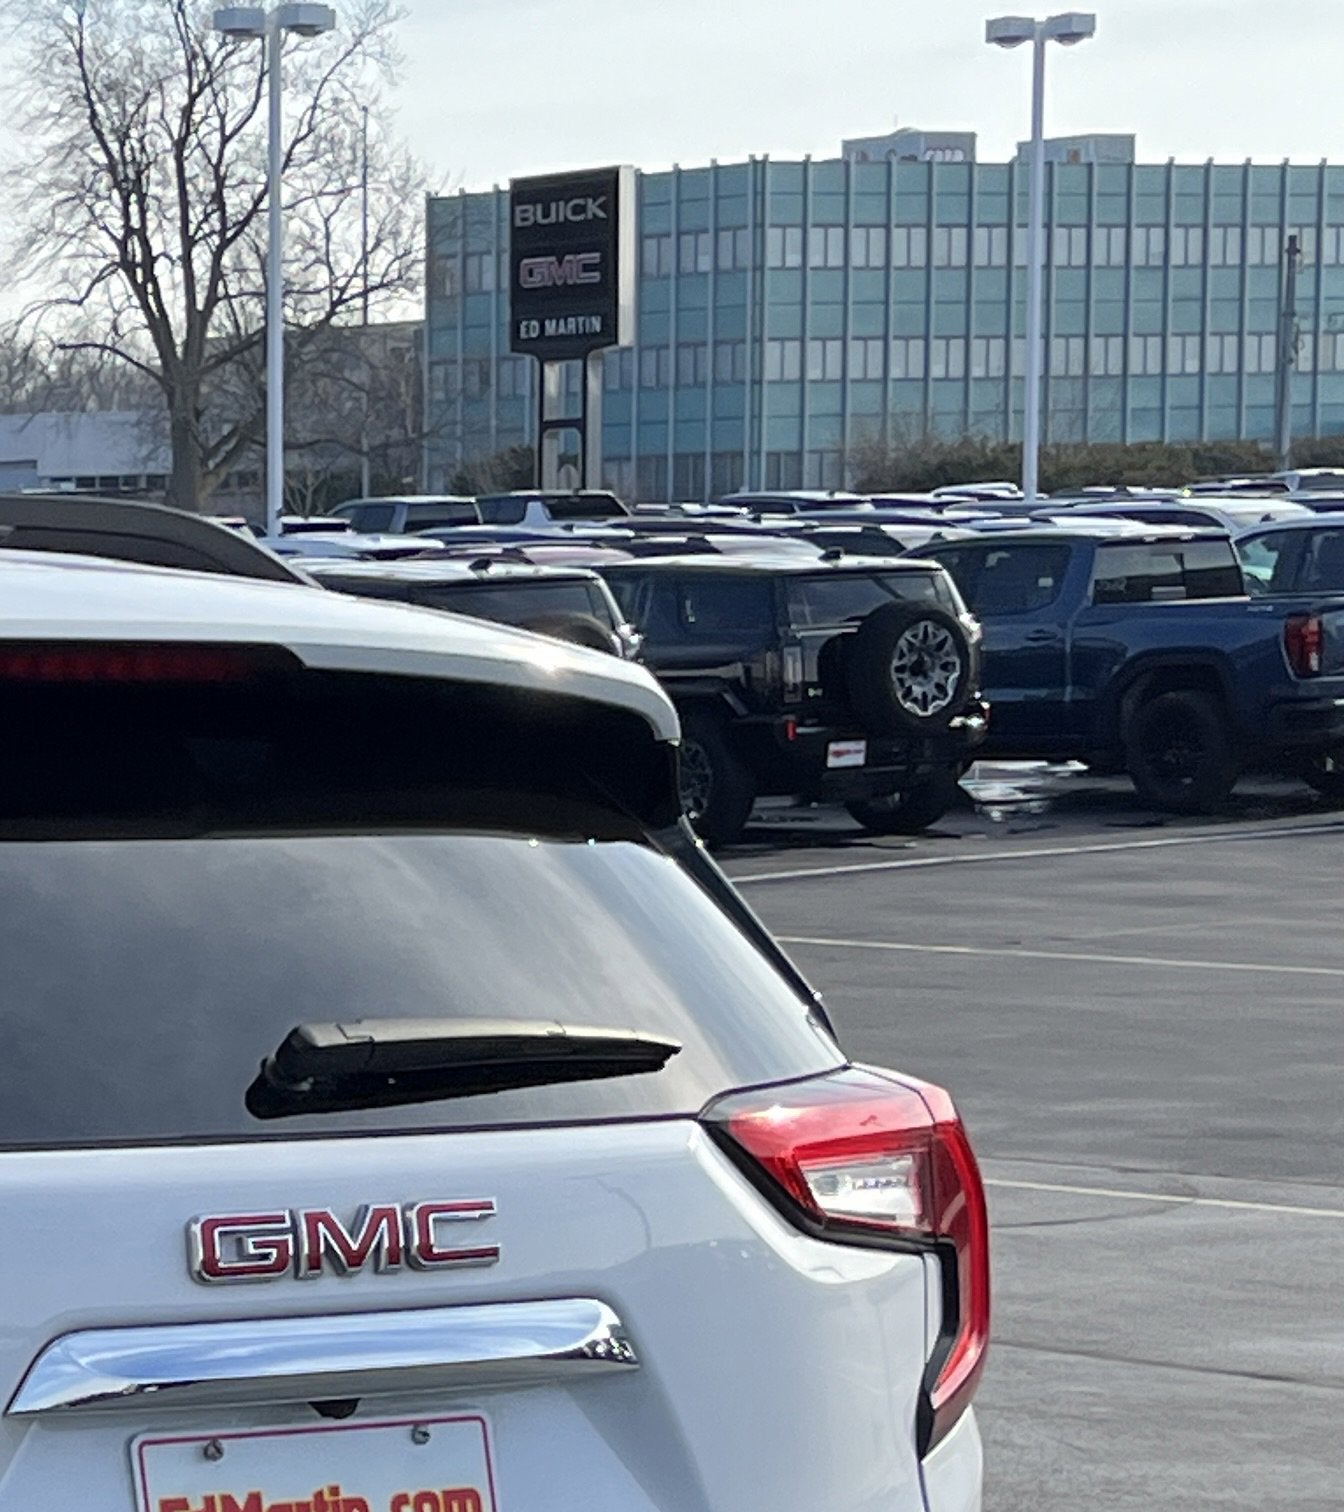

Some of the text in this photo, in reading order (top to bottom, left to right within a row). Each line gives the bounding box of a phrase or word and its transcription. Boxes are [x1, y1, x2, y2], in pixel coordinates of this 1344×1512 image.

[514, 195, 608, 228] BUICK
[519, 251, 602, 289] GMC
[519, 315, 602, 340] ED MARTIN
[185, 1194, 501, 1286] GMC
